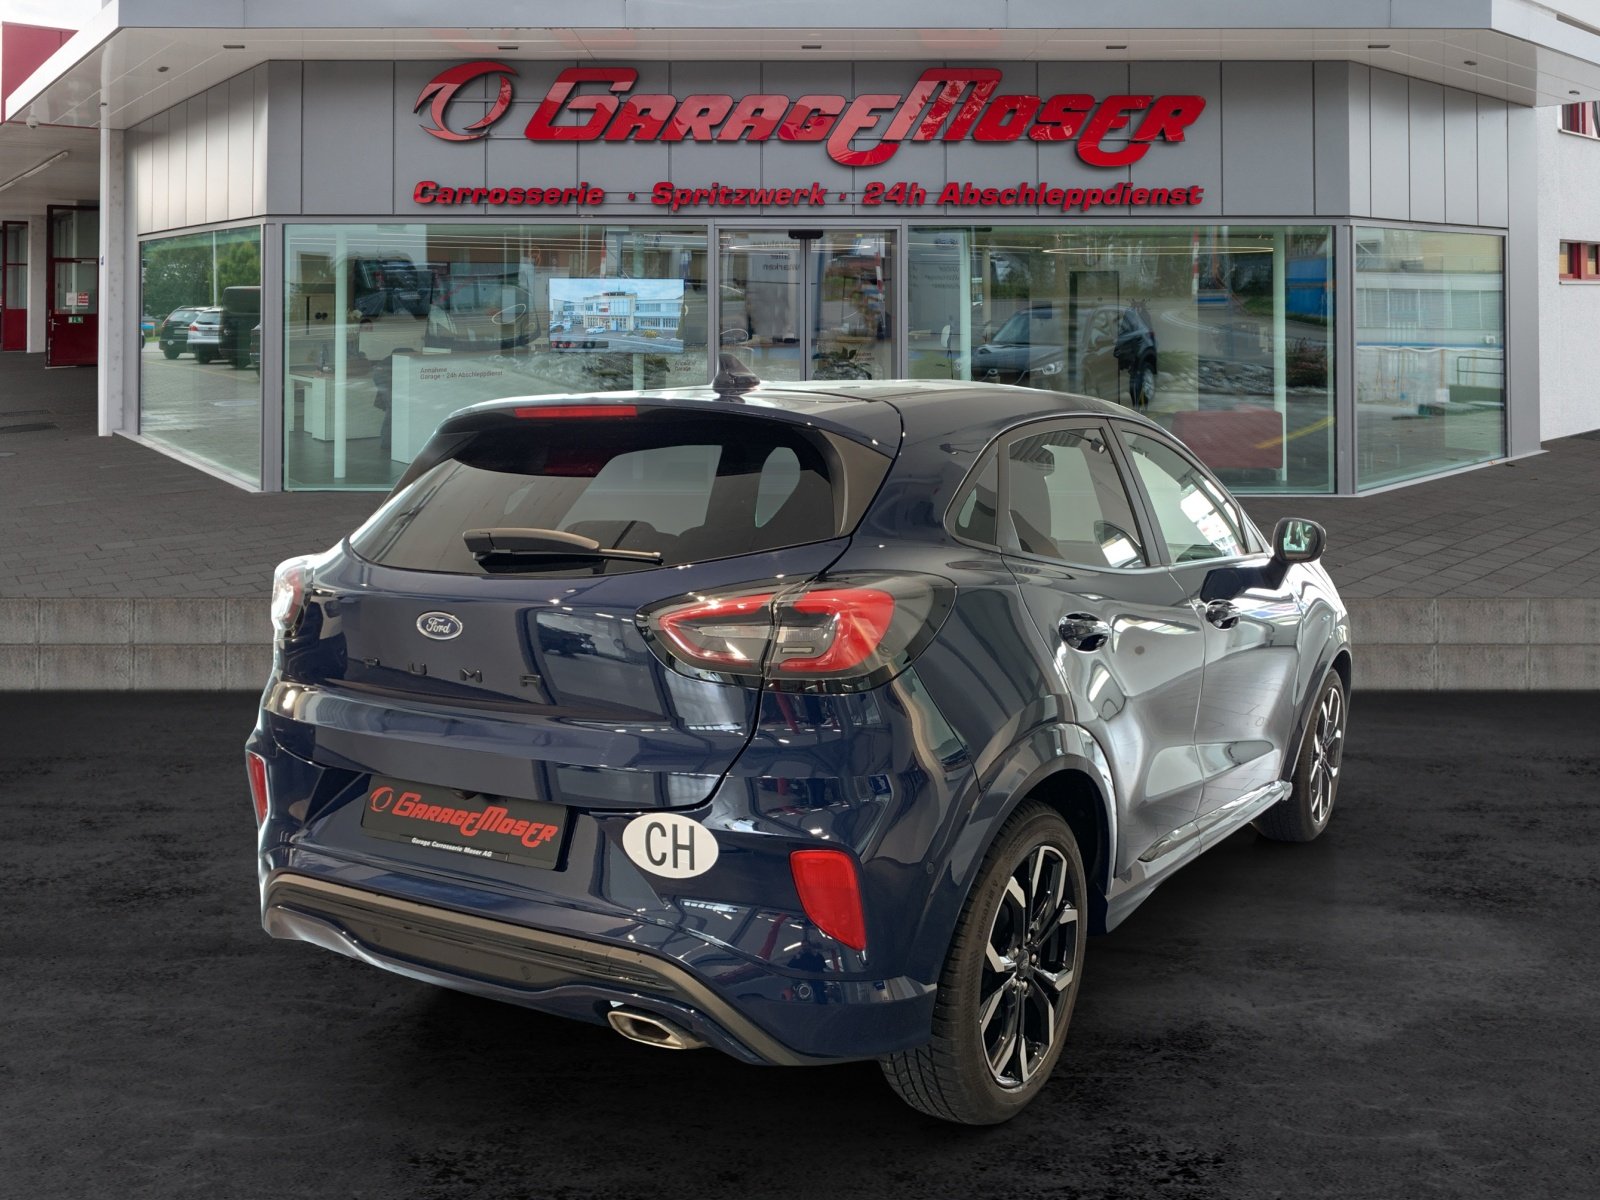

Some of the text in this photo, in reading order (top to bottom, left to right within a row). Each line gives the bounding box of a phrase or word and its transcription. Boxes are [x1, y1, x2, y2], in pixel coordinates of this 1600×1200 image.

[413, 181, 1204, 211] Carrosserie Spritzwerk 24h Abschleppdienst
[426, 617, 451, 634] Ford
[411, 837, 493, 858] Garage Carrosserie Moser AG
[645, 821, 695, 871] CH
